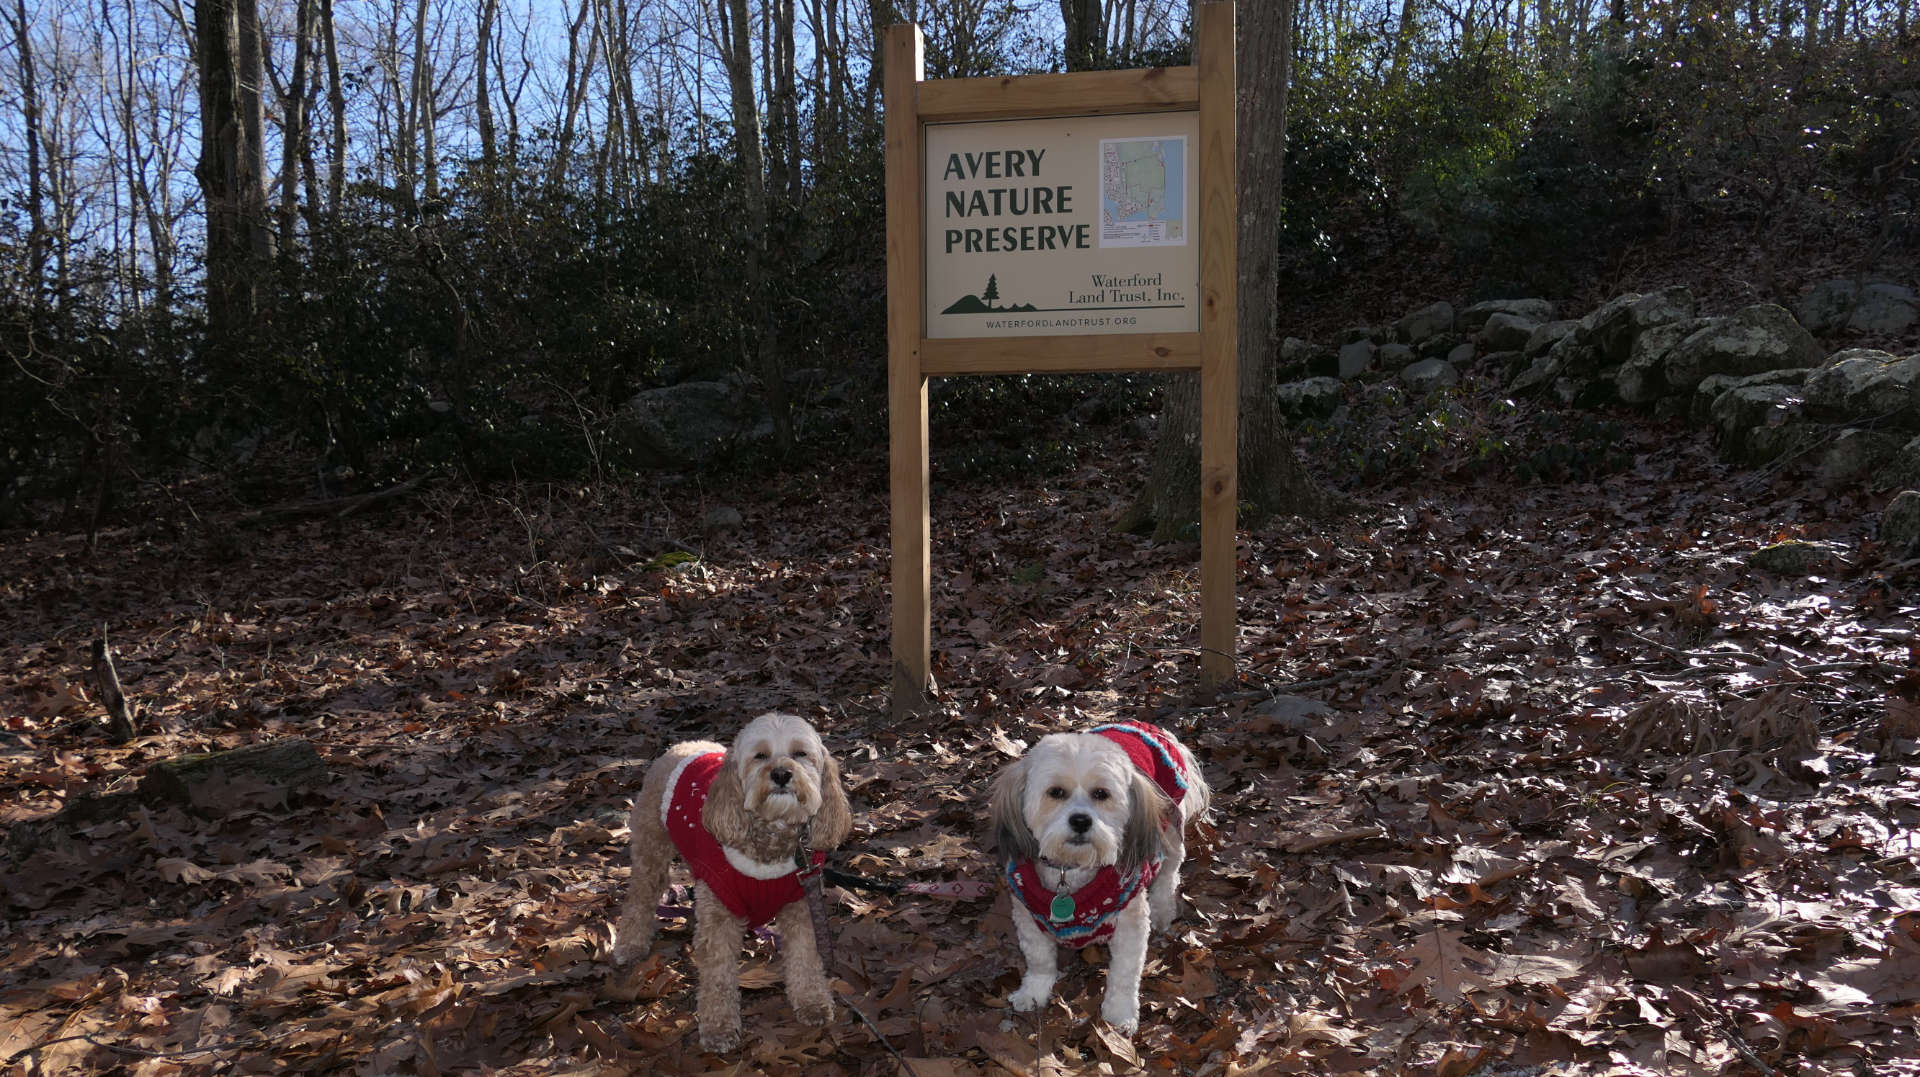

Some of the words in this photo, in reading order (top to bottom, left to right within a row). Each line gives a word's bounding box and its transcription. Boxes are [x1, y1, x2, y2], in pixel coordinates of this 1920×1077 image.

[943, 148, 1046, 180] AVERY
[945, 185, 1073, 218] NATURE
[945, 224, 1091, 254] PRESERVE
[1091, 273, 1162, 288] Waterford
[1068, 289, 1105, 304] Land
[1157, 288, 1185, 302] Inc.
[985, 317, 1137, 330] WATERFORDLANDTRUST.ORG
